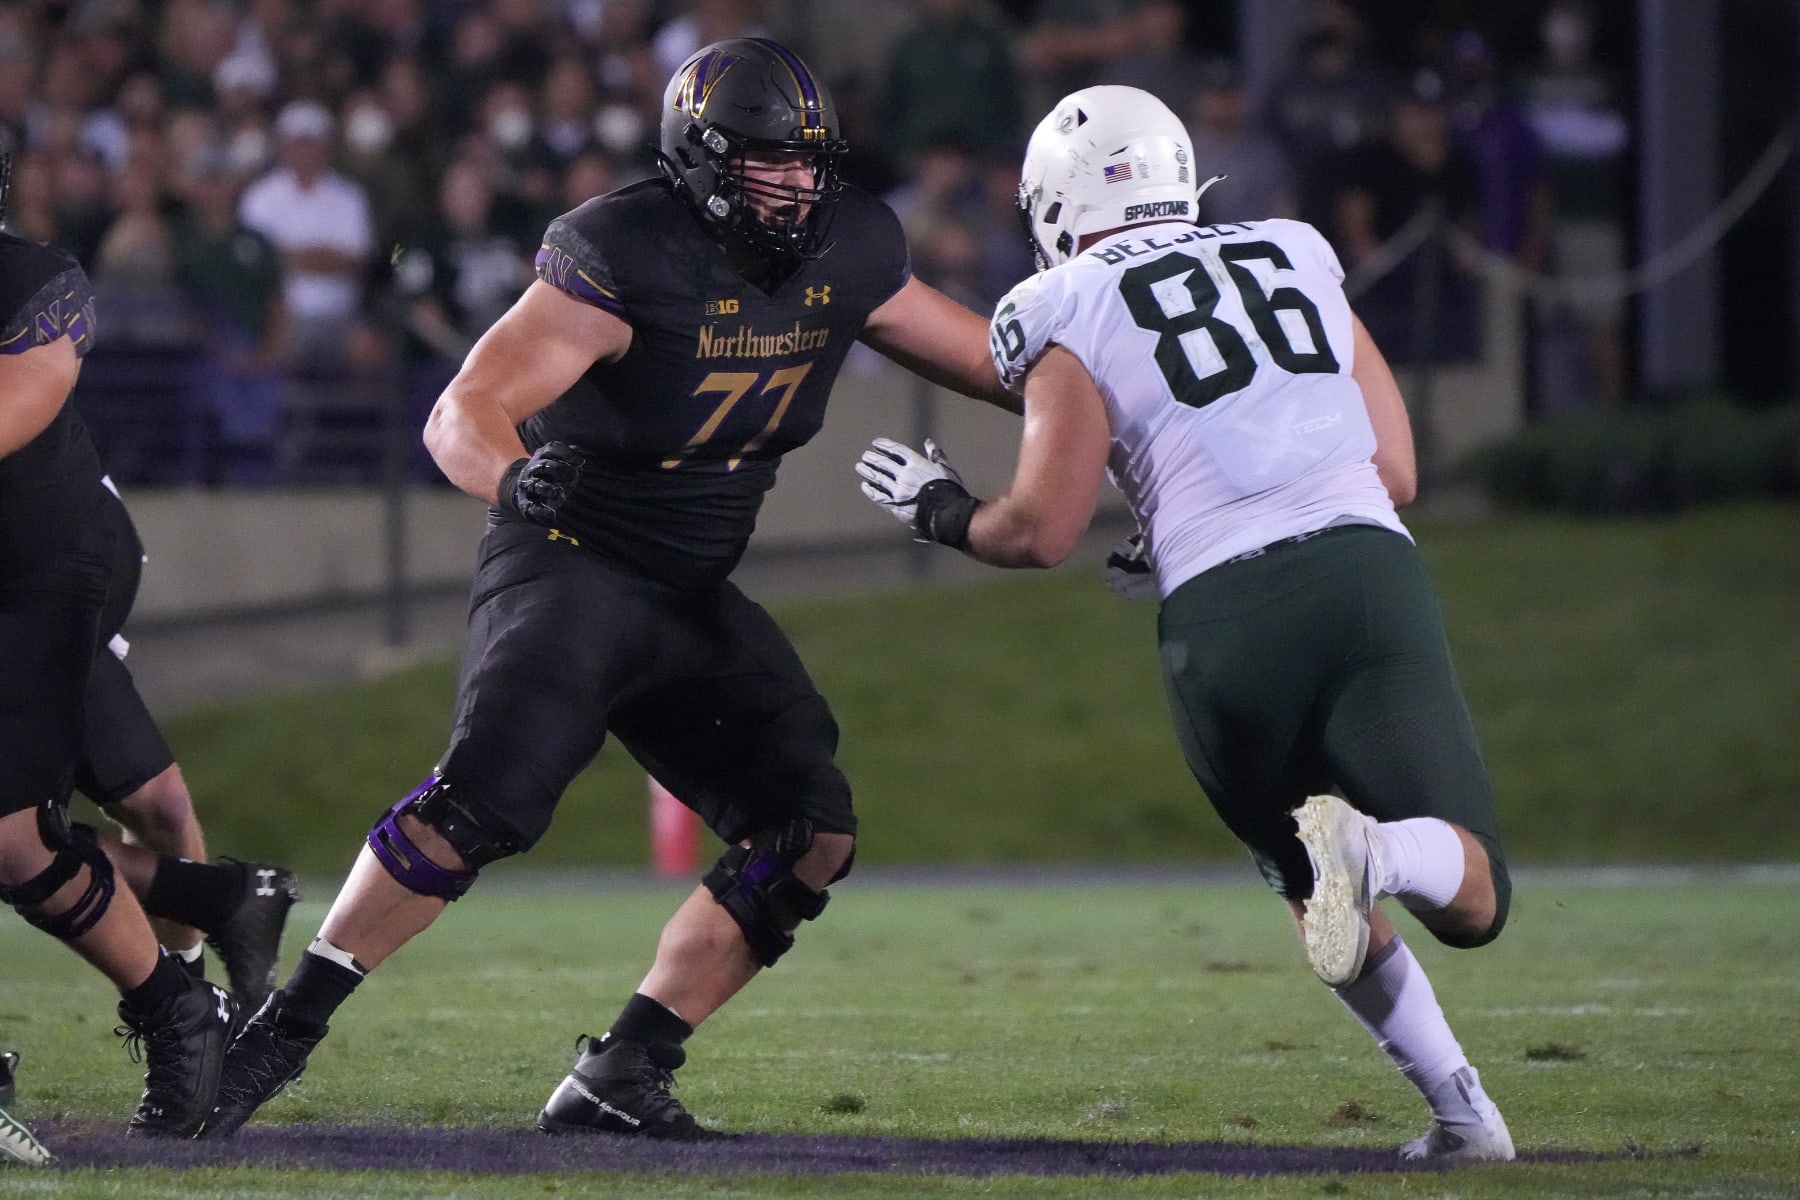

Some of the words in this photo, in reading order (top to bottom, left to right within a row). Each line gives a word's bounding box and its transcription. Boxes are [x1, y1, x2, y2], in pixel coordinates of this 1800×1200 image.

[1125, 201, 1189, 221] SPARTANS
[696, 320, 830, 359] Northwestern
[1119, 240, 1340, 408] 86
[660, 361, 814, 471] 77
[599, 1102, 641, 1126] ARMOUR
